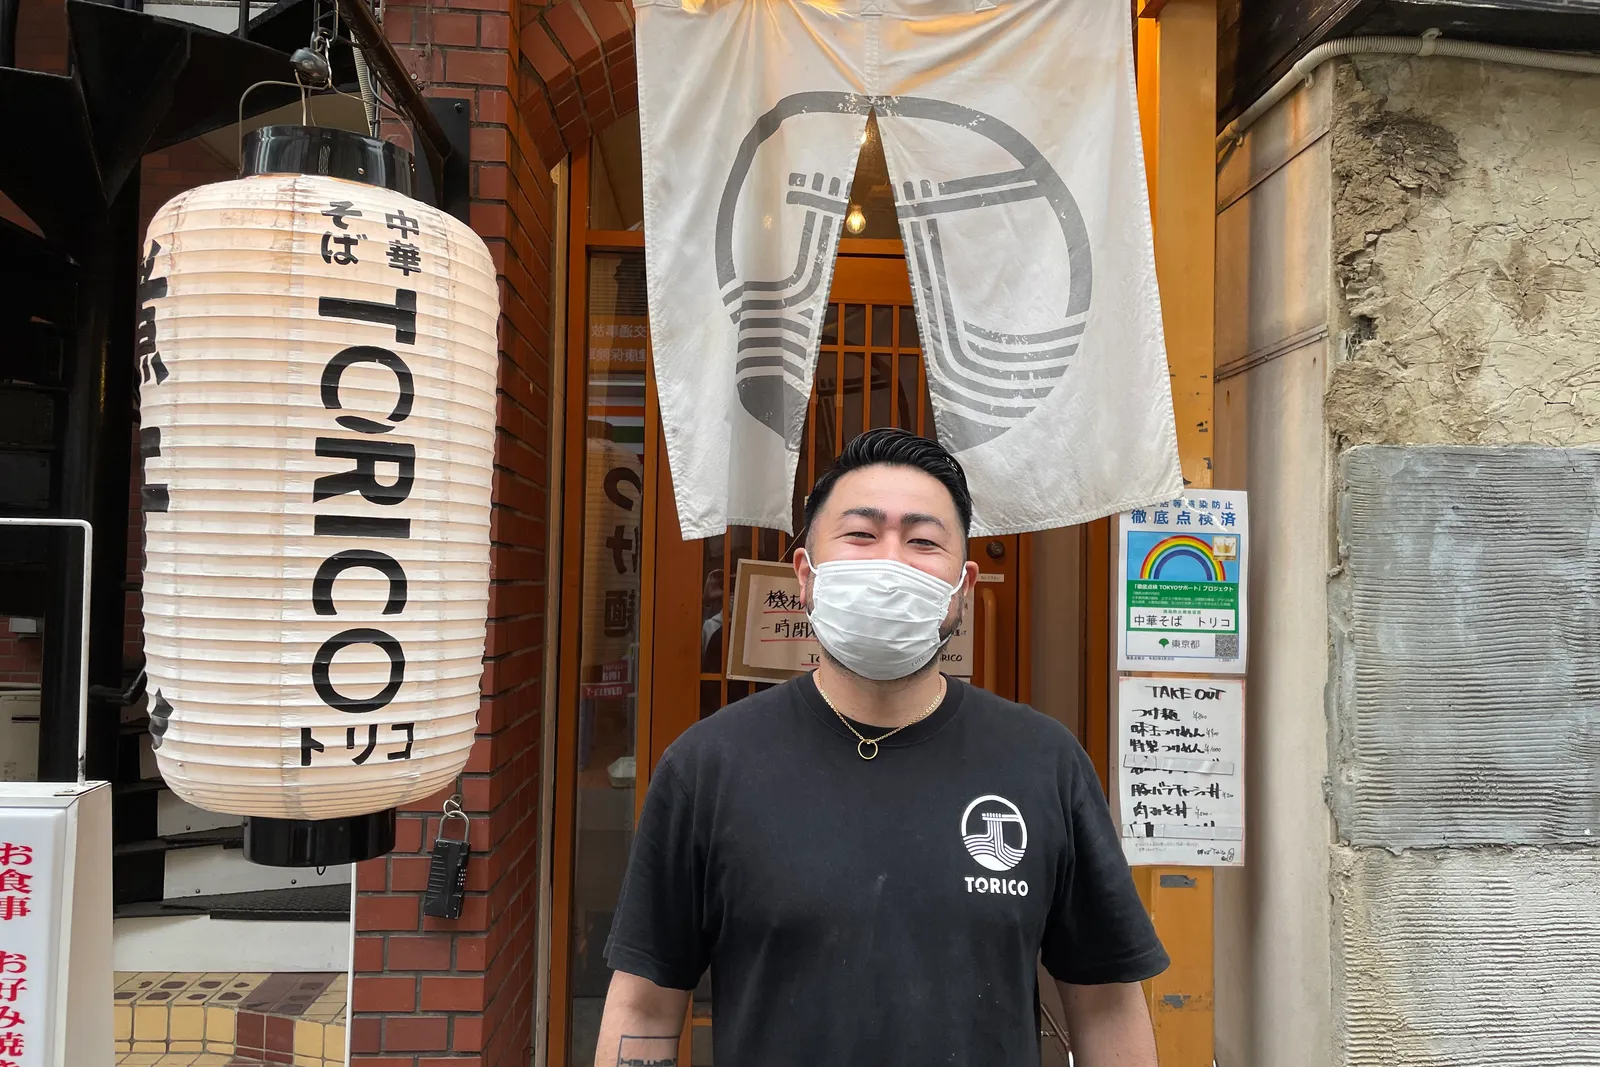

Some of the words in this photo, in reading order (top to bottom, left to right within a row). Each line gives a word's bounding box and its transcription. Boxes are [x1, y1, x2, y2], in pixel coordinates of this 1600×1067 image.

[320, 200, 368, 266] そば
[385, 210, 422, 277] 中華
[312, 288, 418, 714] TORICO
[1131, 509, 1237, 527] 徹底点検済
[1134, 614, 1183, 627] 中華そば
[1198, 617, 1231, 629] トリコ
[1171, 639, 1201, 649] 東京都
[1145, 685, 1192, 701] TAKE
[300, 722, 415, 767] トリコ
[0, 842, 33, 921] お食事
[964, 876, 1029, 896] TORICO
[0, 950, 29, 1067] お好み焼
